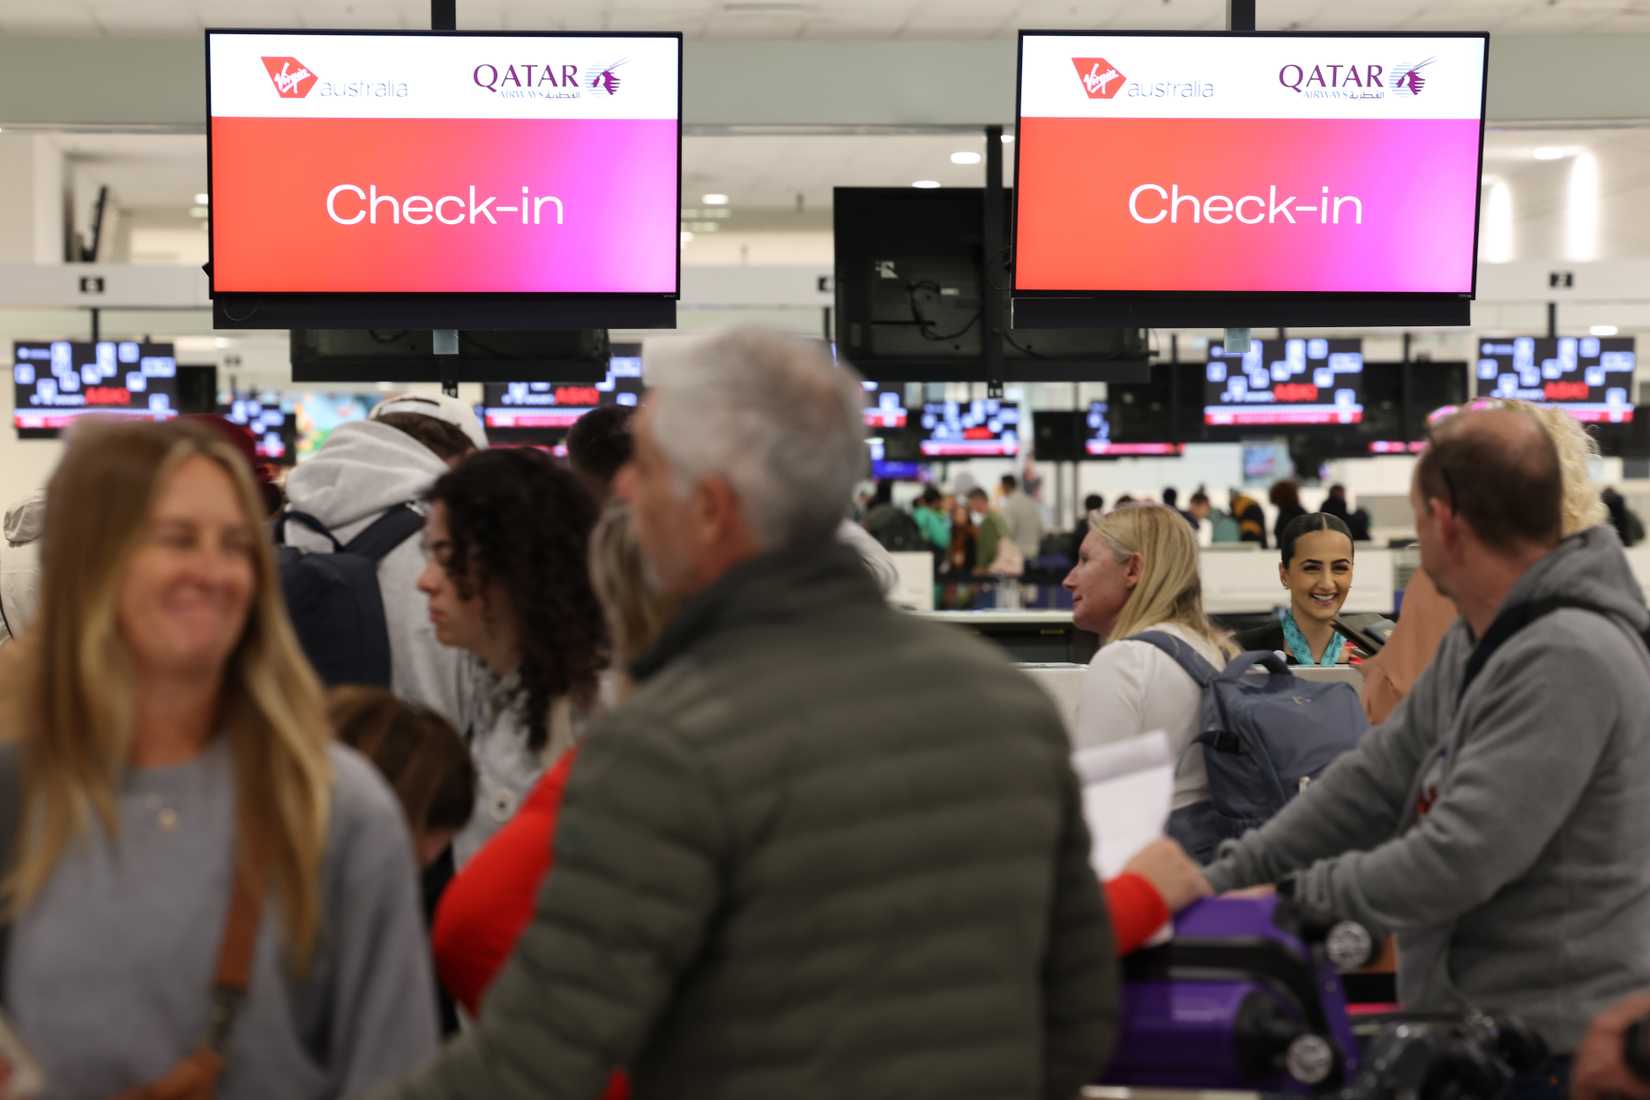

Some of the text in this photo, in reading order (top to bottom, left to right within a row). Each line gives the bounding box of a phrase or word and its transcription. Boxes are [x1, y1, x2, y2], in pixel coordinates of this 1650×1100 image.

[274, 61, 311, 94] Virgin
[320, 80, 408, 98] australia
[472, 63, 580, 92] QATAR
[1083, 62, 1119, 95] Virgin
[1127, 80, 1214, 98] australia
[1278, 64, 1385, 92] QATAR
[326, 184, 564, 225] Check-in
[1128, 183, 1362, 225] Check-in
